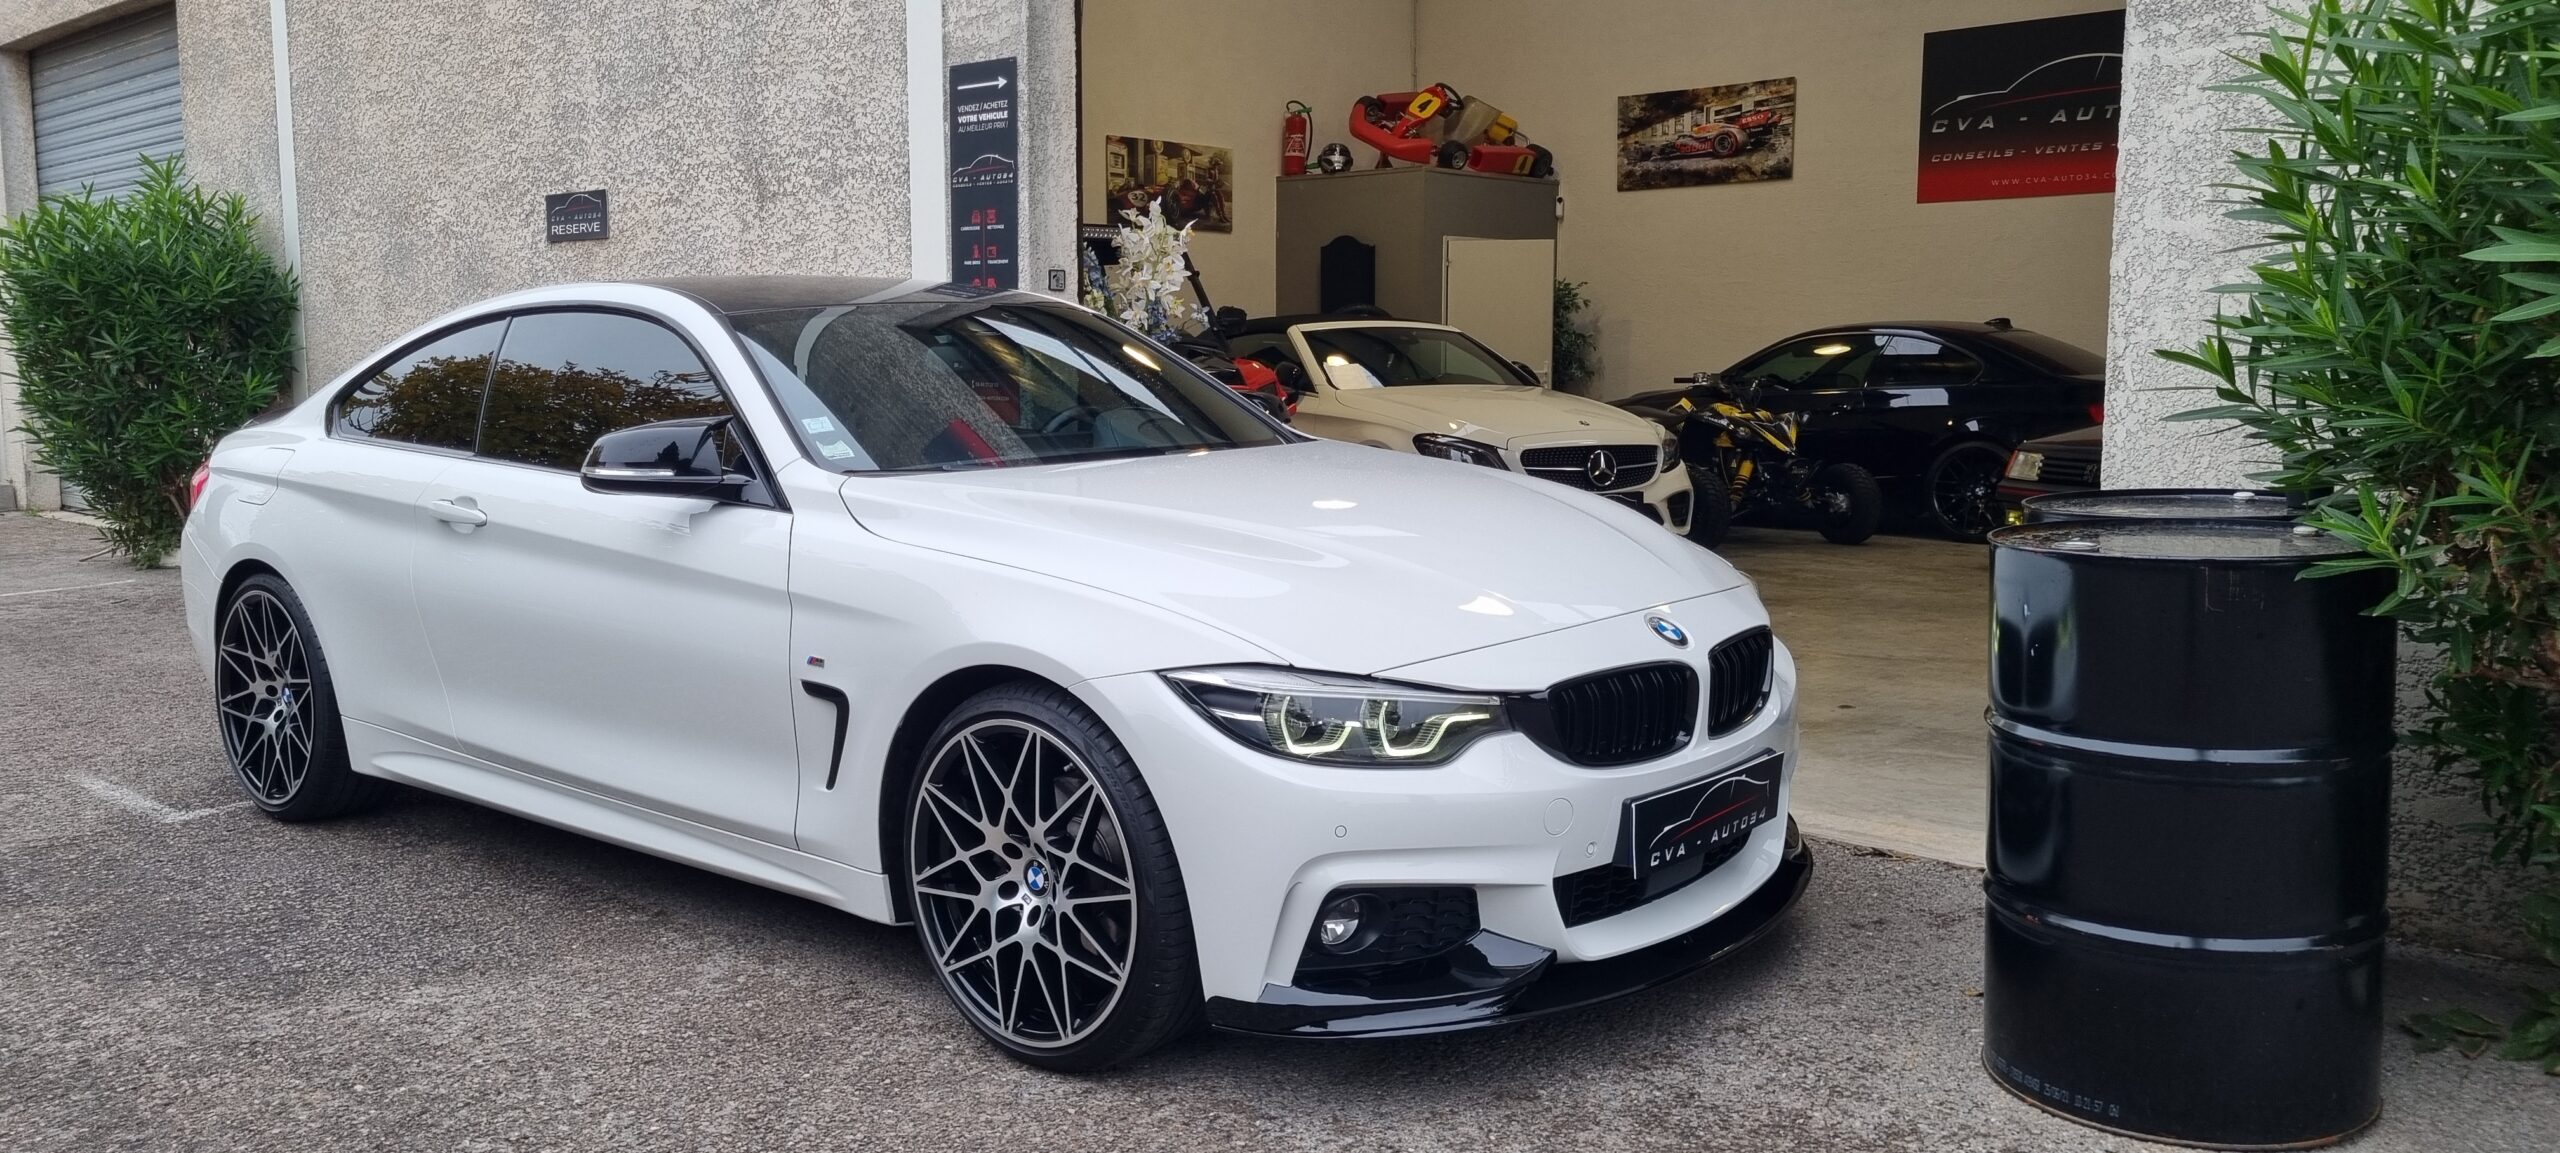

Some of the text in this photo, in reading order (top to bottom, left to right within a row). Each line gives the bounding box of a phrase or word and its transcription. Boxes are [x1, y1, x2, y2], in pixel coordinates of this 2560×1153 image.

[1418, 99, 1432, 113] 4
[957, 110, 1008, 124] VOTRE VEHICULE
[1931, 115, 1994, 133] CVA
[1931, 149, 2014, 162] CONSEILS
[2035, 142, 2103, 154] VENTES
[1131, 193, 1146, 202] 32
[551, 221, 601, 235] RESERVE
[1650, 843, 1686, 867] CVA
[1710, 807, 1767, 843] AUTO34
